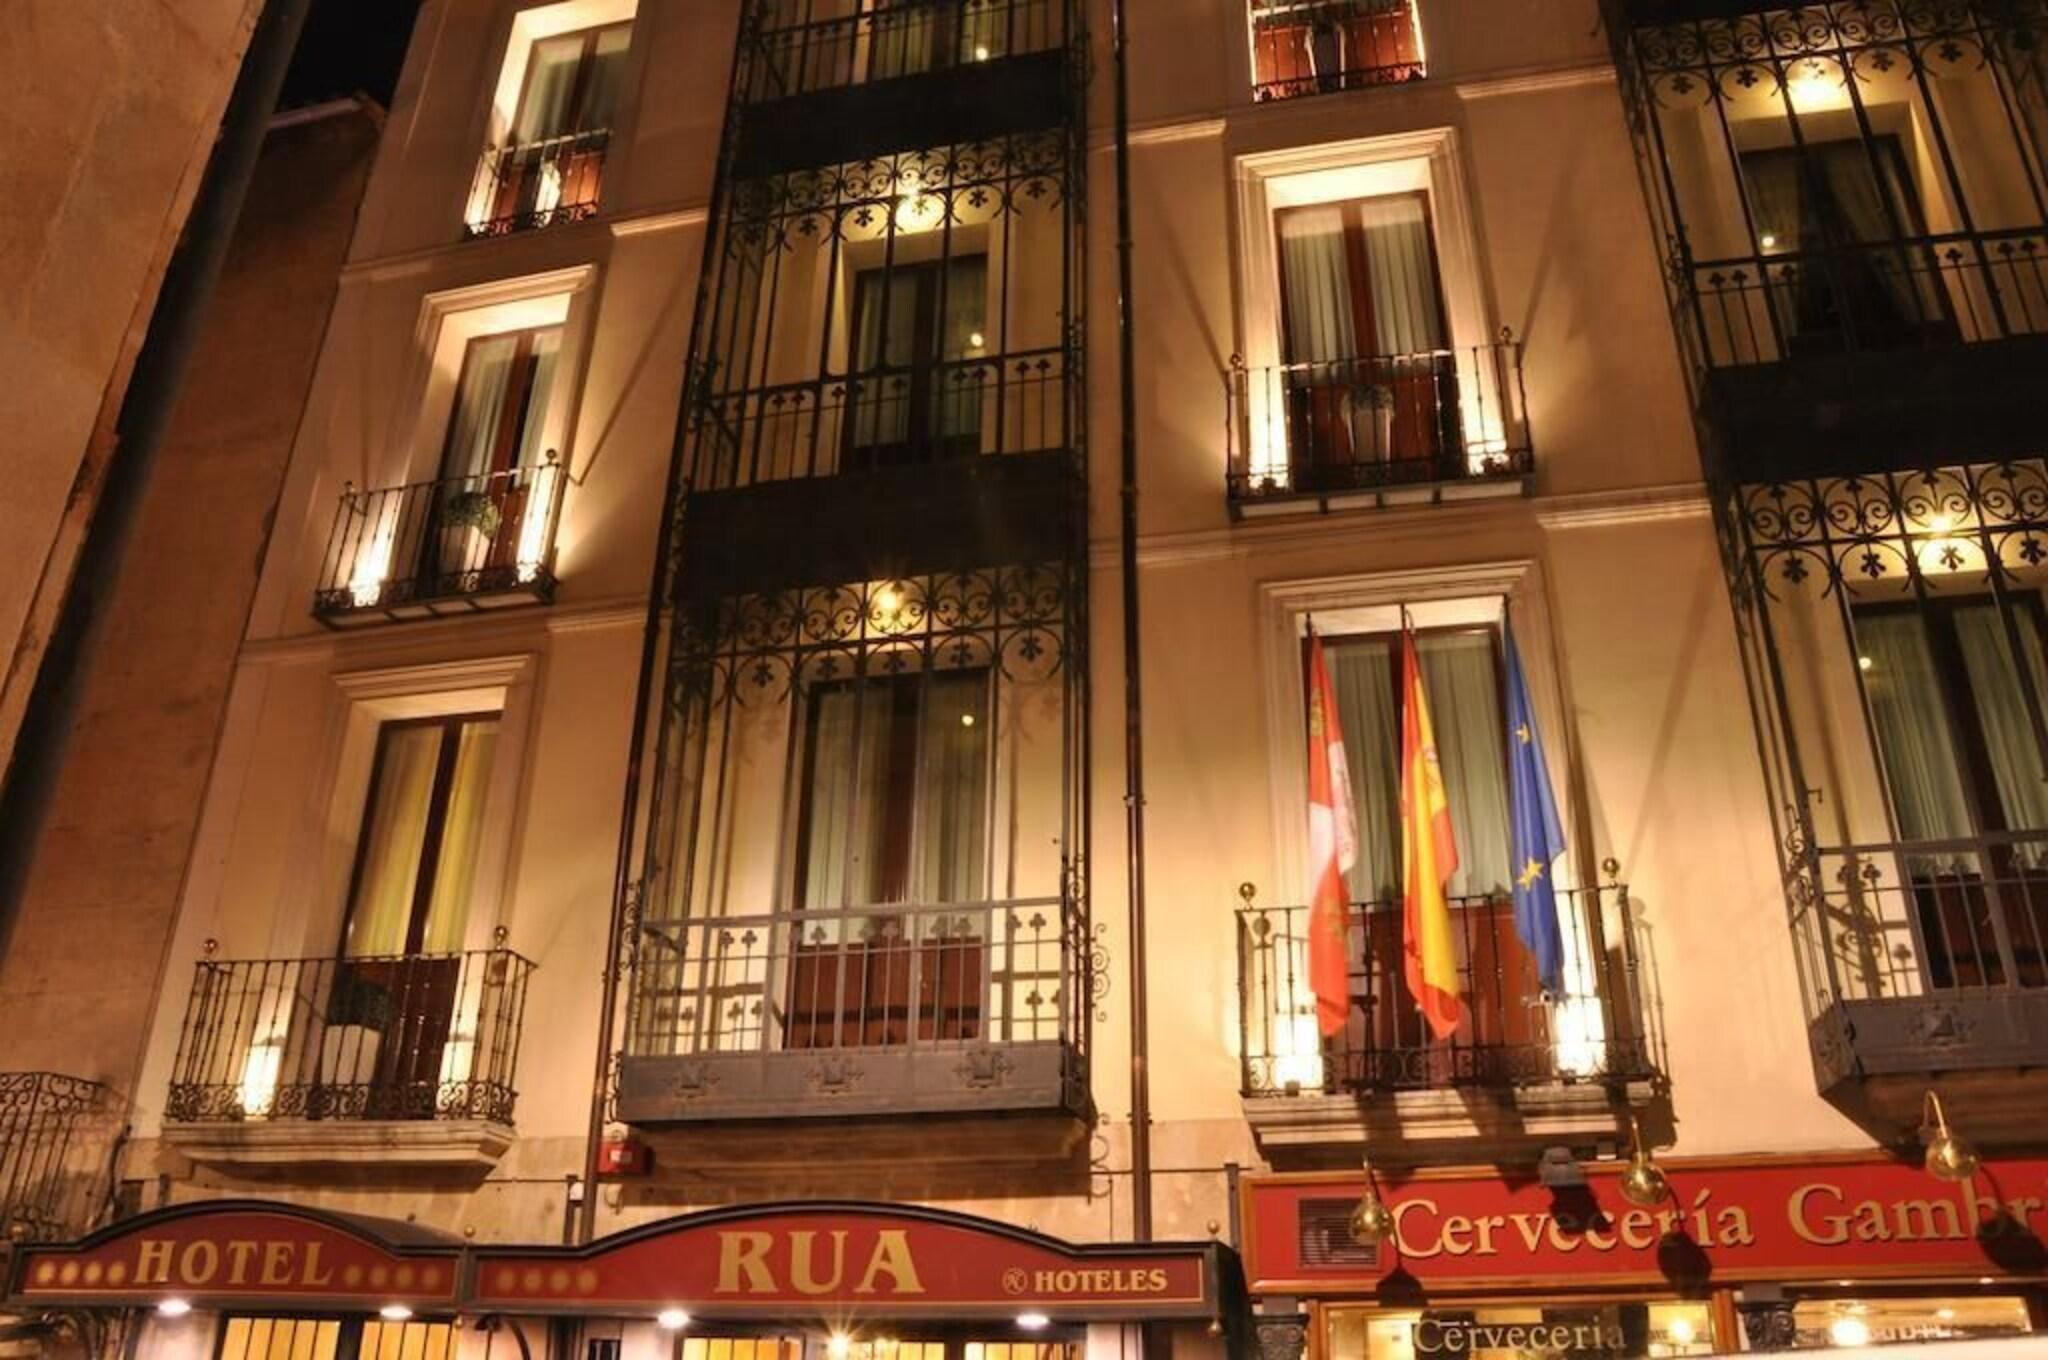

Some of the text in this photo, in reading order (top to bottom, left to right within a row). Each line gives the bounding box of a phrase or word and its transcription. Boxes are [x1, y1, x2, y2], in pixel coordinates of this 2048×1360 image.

[133, 1239, 335, 1286] HOTEL
[714, 1229, 926, 1294] RUA
[1034, 1268, 1168, 1293] HOTELES
